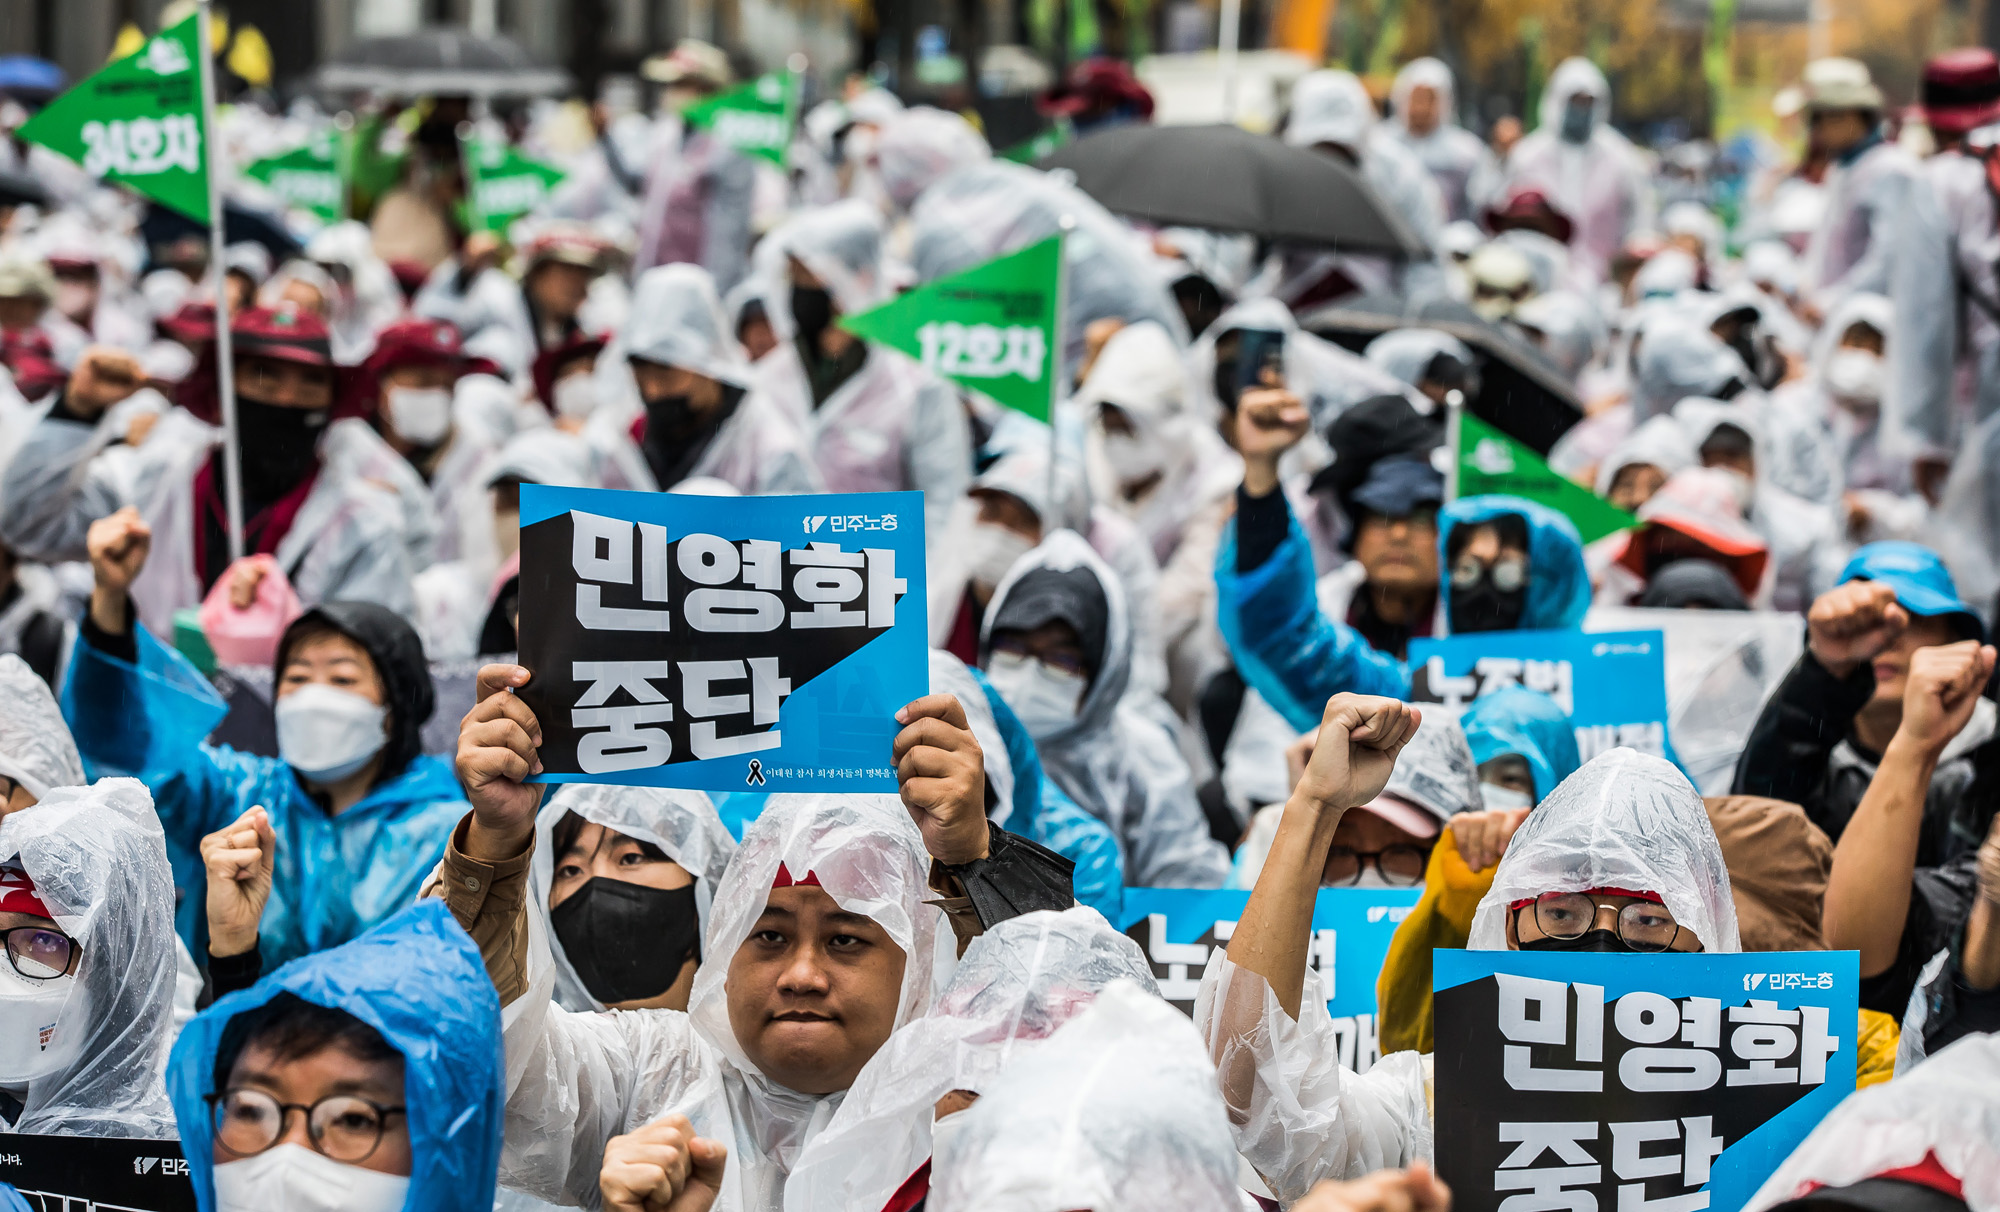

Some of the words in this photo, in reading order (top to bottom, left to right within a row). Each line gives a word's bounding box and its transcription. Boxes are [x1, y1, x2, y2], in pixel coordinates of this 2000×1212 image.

[915, 320, 1048, 381] 12호차
[830, 513, 898, 532] 민주노총
[570, 509, 908, 633] 민영화
[571, 657, 791, 775] 중단
[766, 768, 793, 779] 이태원
[795, 768, 814, 779] 참사
[817, 768, 863, 779] 희생자들의
[865, 768, 891, 779] 명복을
[1769, 972, 1834, 990] 민주노총
[1494, 973, 1839, 1093] 민영화
[1494, 1115, 1724, 1212] 중단
